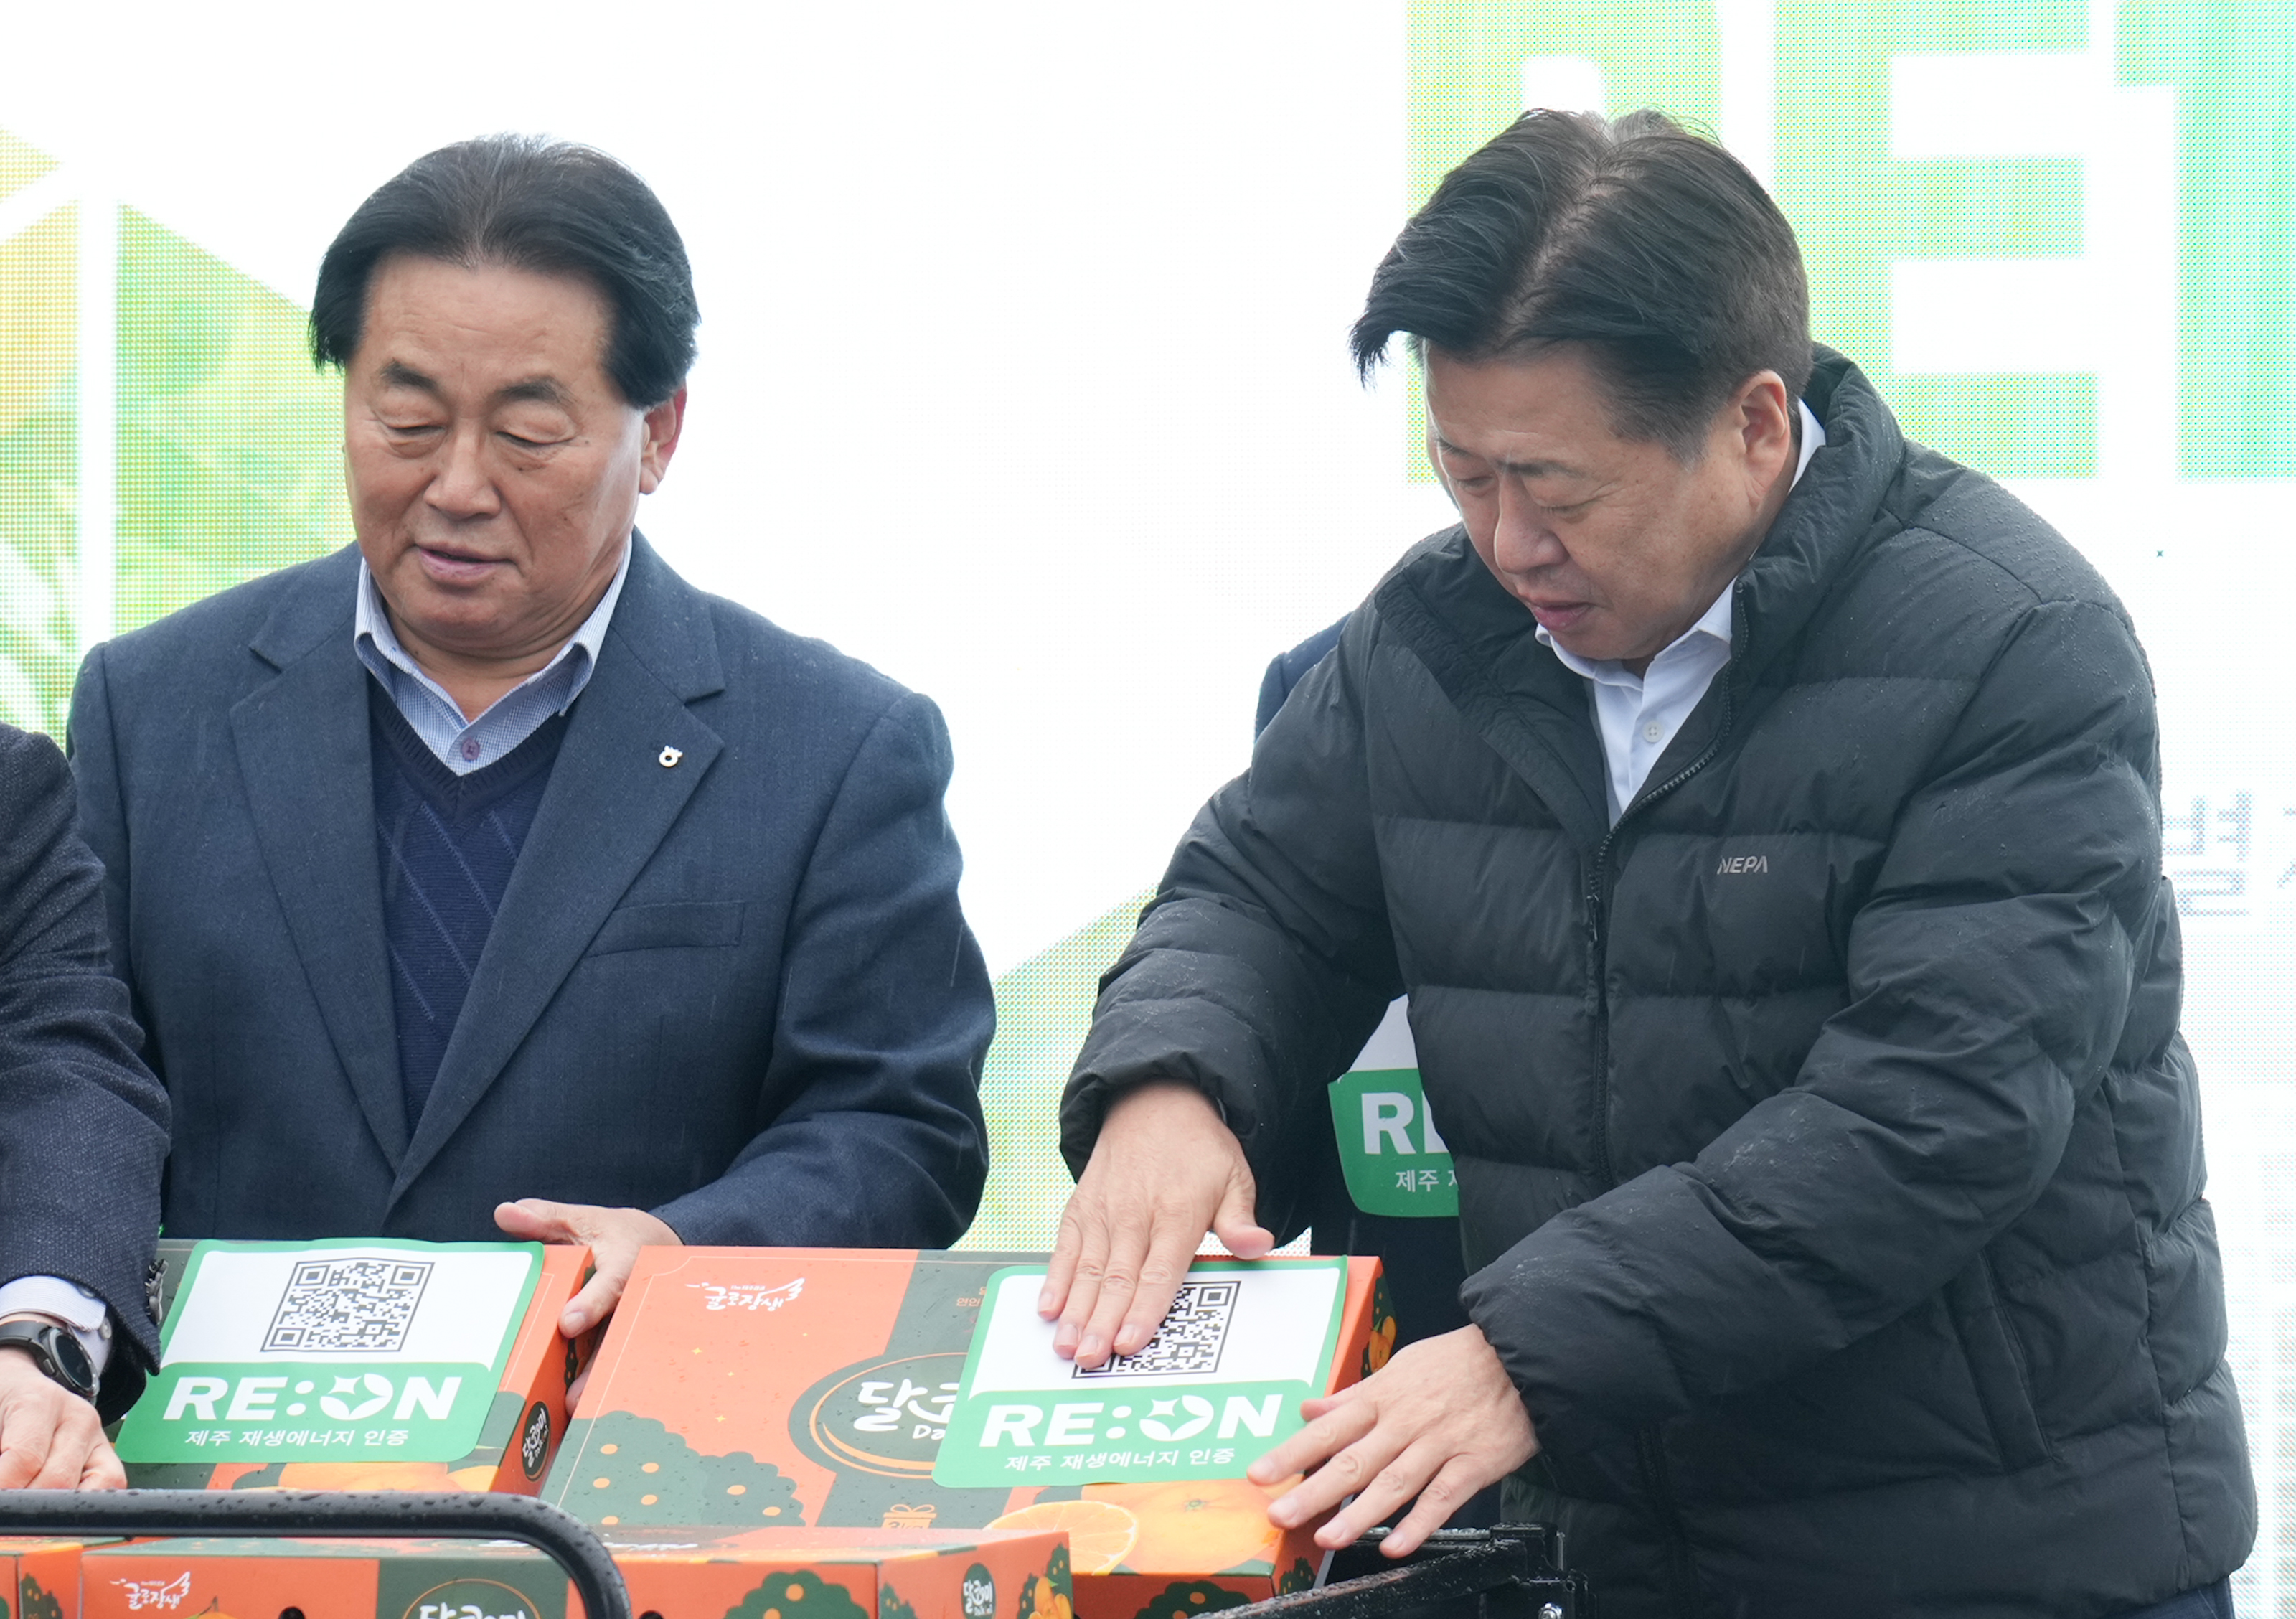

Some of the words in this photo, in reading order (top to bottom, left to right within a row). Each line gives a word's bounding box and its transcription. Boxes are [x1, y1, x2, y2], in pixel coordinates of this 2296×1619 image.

[1717, 855, 1767, 874] NEPA
[1396, 1170, 1439, 1193] 제주
[185, 1430, 231, 1447] 제주
[239, 1429, 356, 1447] 재생에너지
[364, 1430, 409, 1447] 인증
[1004, 1455, 1052, 1471] 제주
[1060, 1450, 1180, 1470] 재생에너지
[1188, 1447, 1235, 1465] 인증
